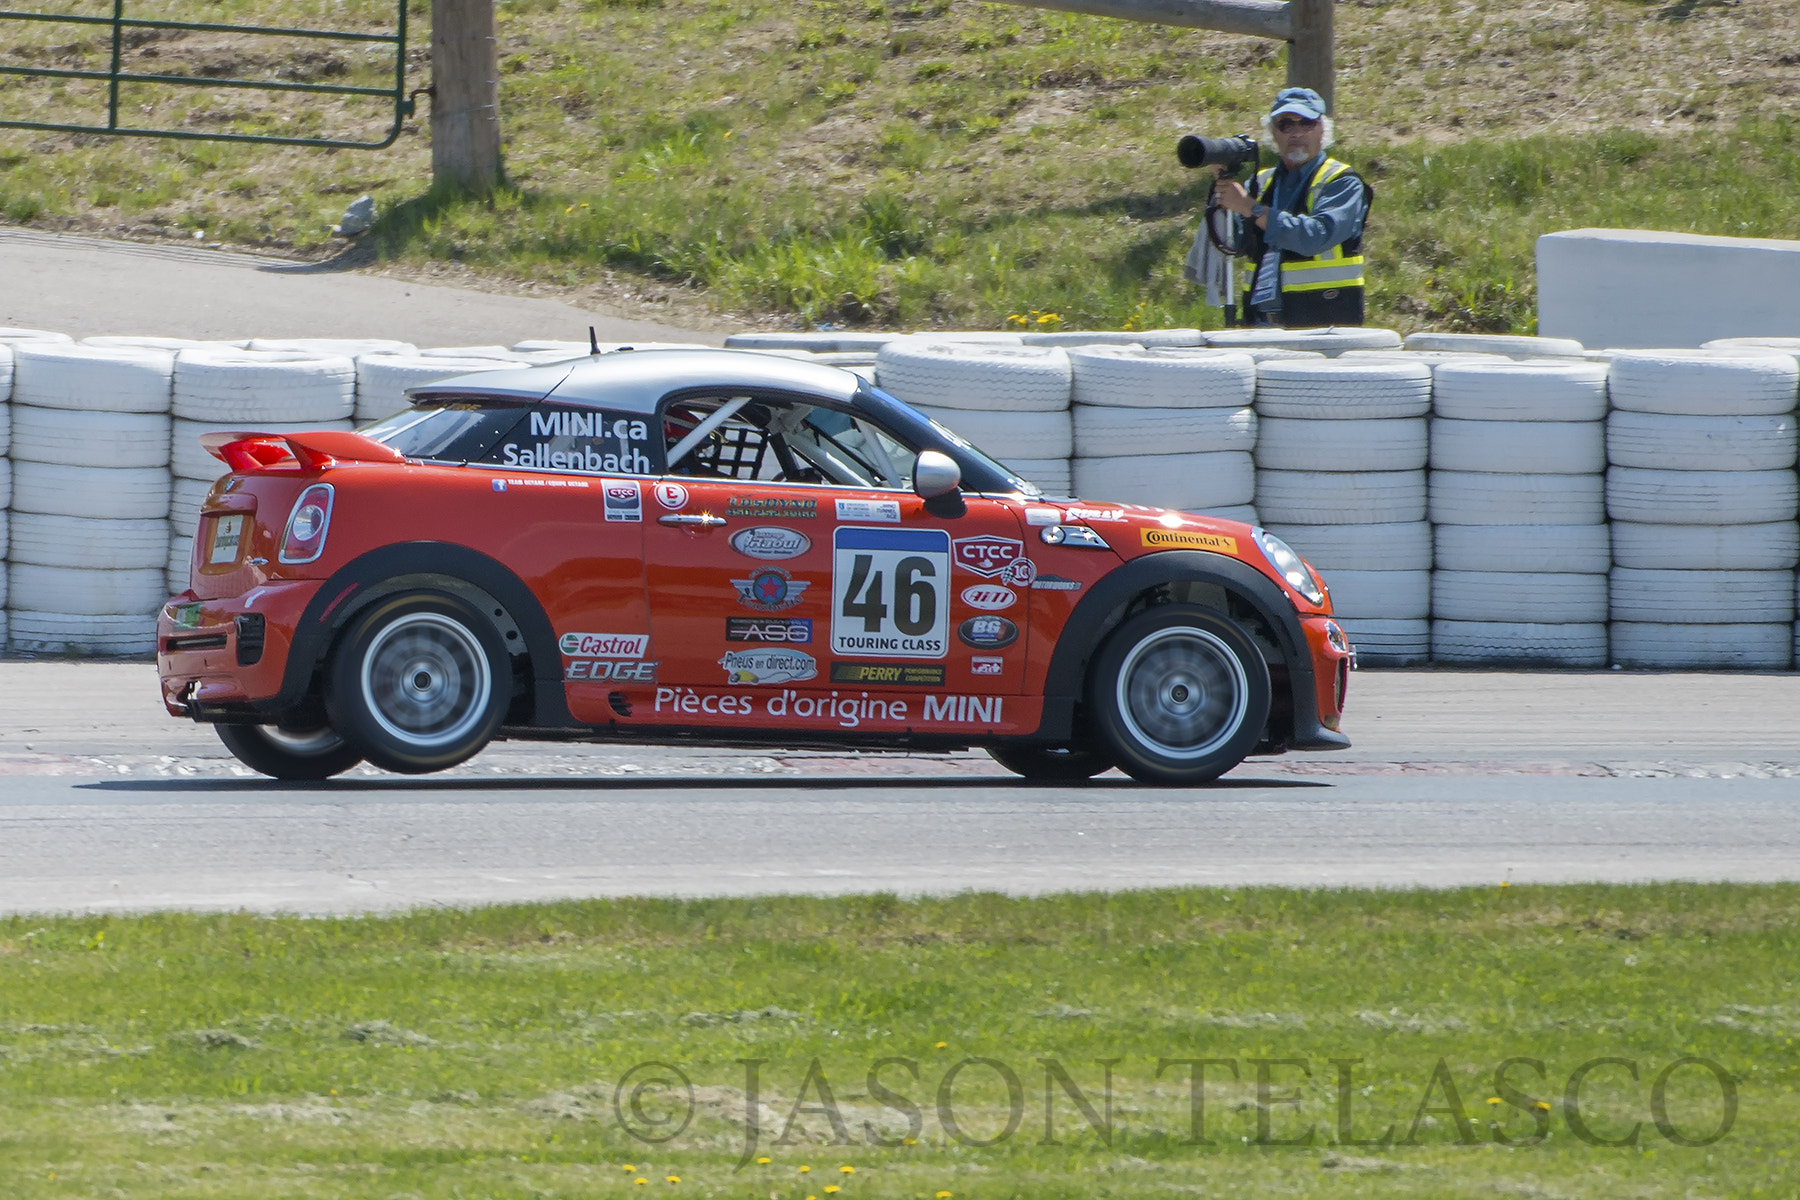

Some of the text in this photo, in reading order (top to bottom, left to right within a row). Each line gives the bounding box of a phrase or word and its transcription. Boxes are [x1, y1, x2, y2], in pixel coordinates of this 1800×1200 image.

[530, 411, 648, 440] MINI.ca
[503, 443, 650, 474] Sallenbach
[610, 488, 635, 497] CTCC
[666, 486, 678, 499] E
[748, 536, 803, 550] Raoul
[1145, 530, 1220, 547] Continental
[962, 544, 1013, 559] CTCC
[842, 554, 936, 637] 46
[743, 623, 809, 642] ASG
[972, 619, 1002, 634] BG
[579, 635, 643, 655] Castrol
[838, 636, 941, 651] TOURING CLASS
[564, 660, 656, 681] EDGE
[723, 652, 754, 670] Pneus
[766, 654, 815, 671] direct.com
[859, 666, 903, 681] PERRY
[654, 687, 1003, 728] Pièces d'origine MINI
